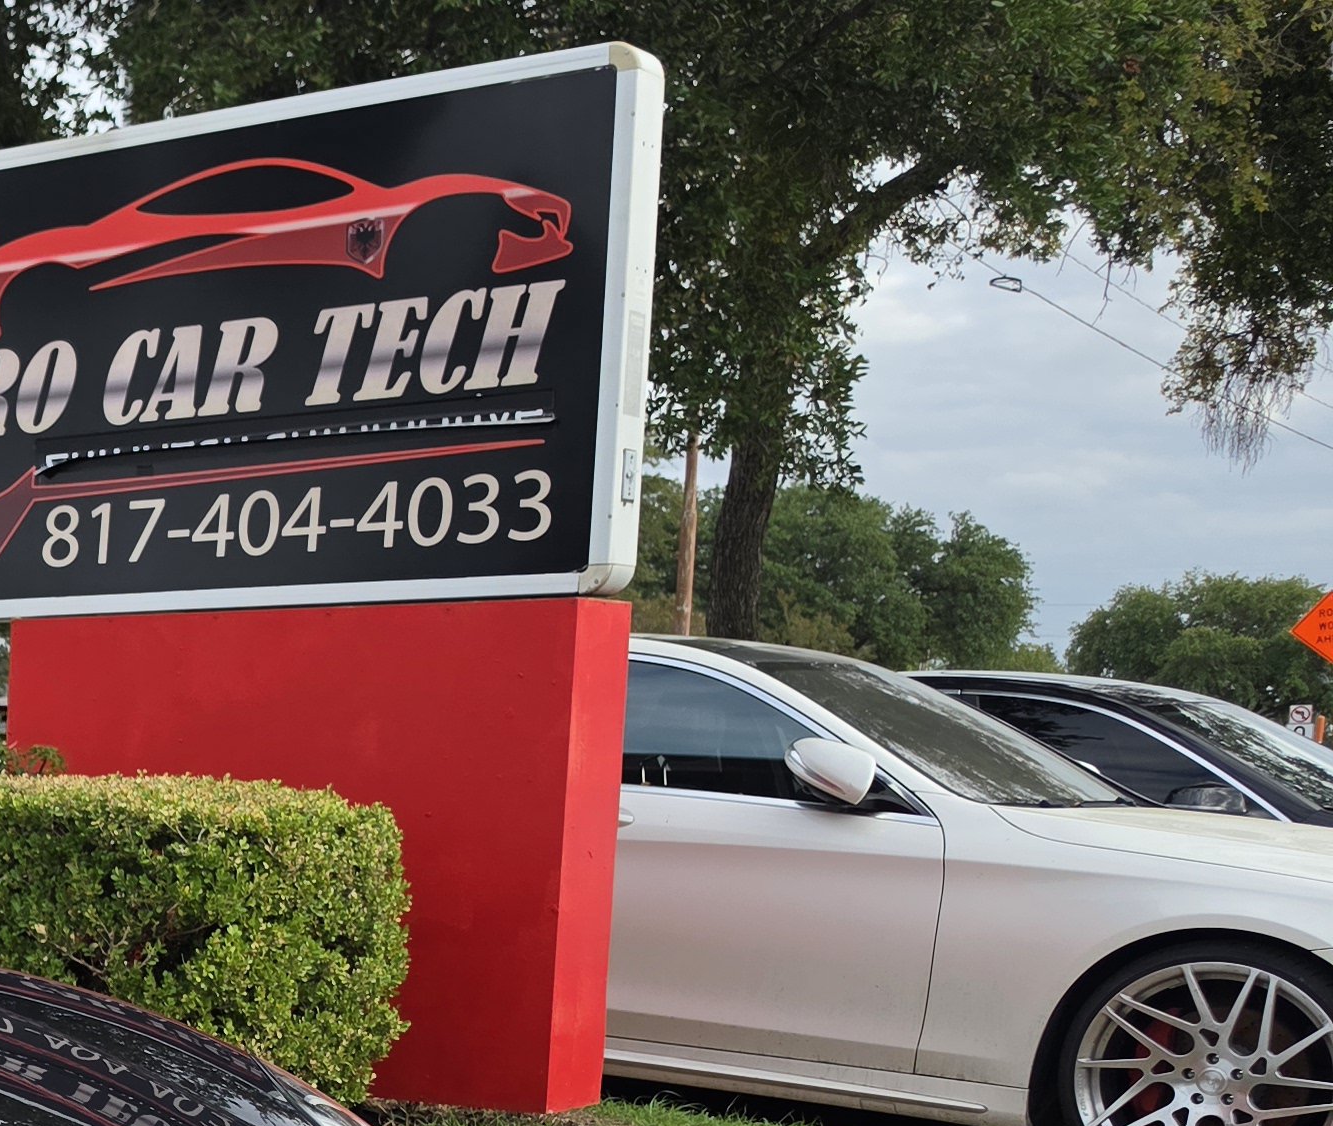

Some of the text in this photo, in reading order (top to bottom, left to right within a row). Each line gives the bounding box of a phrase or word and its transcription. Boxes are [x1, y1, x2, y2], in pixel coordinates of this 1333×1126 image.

[102, 316, 279, 426] CAR
[304, 278, 566, 407] TECH
[40, 468, 553, 569] 817-404-4033
[1316, 635, 1333, 644] AH
